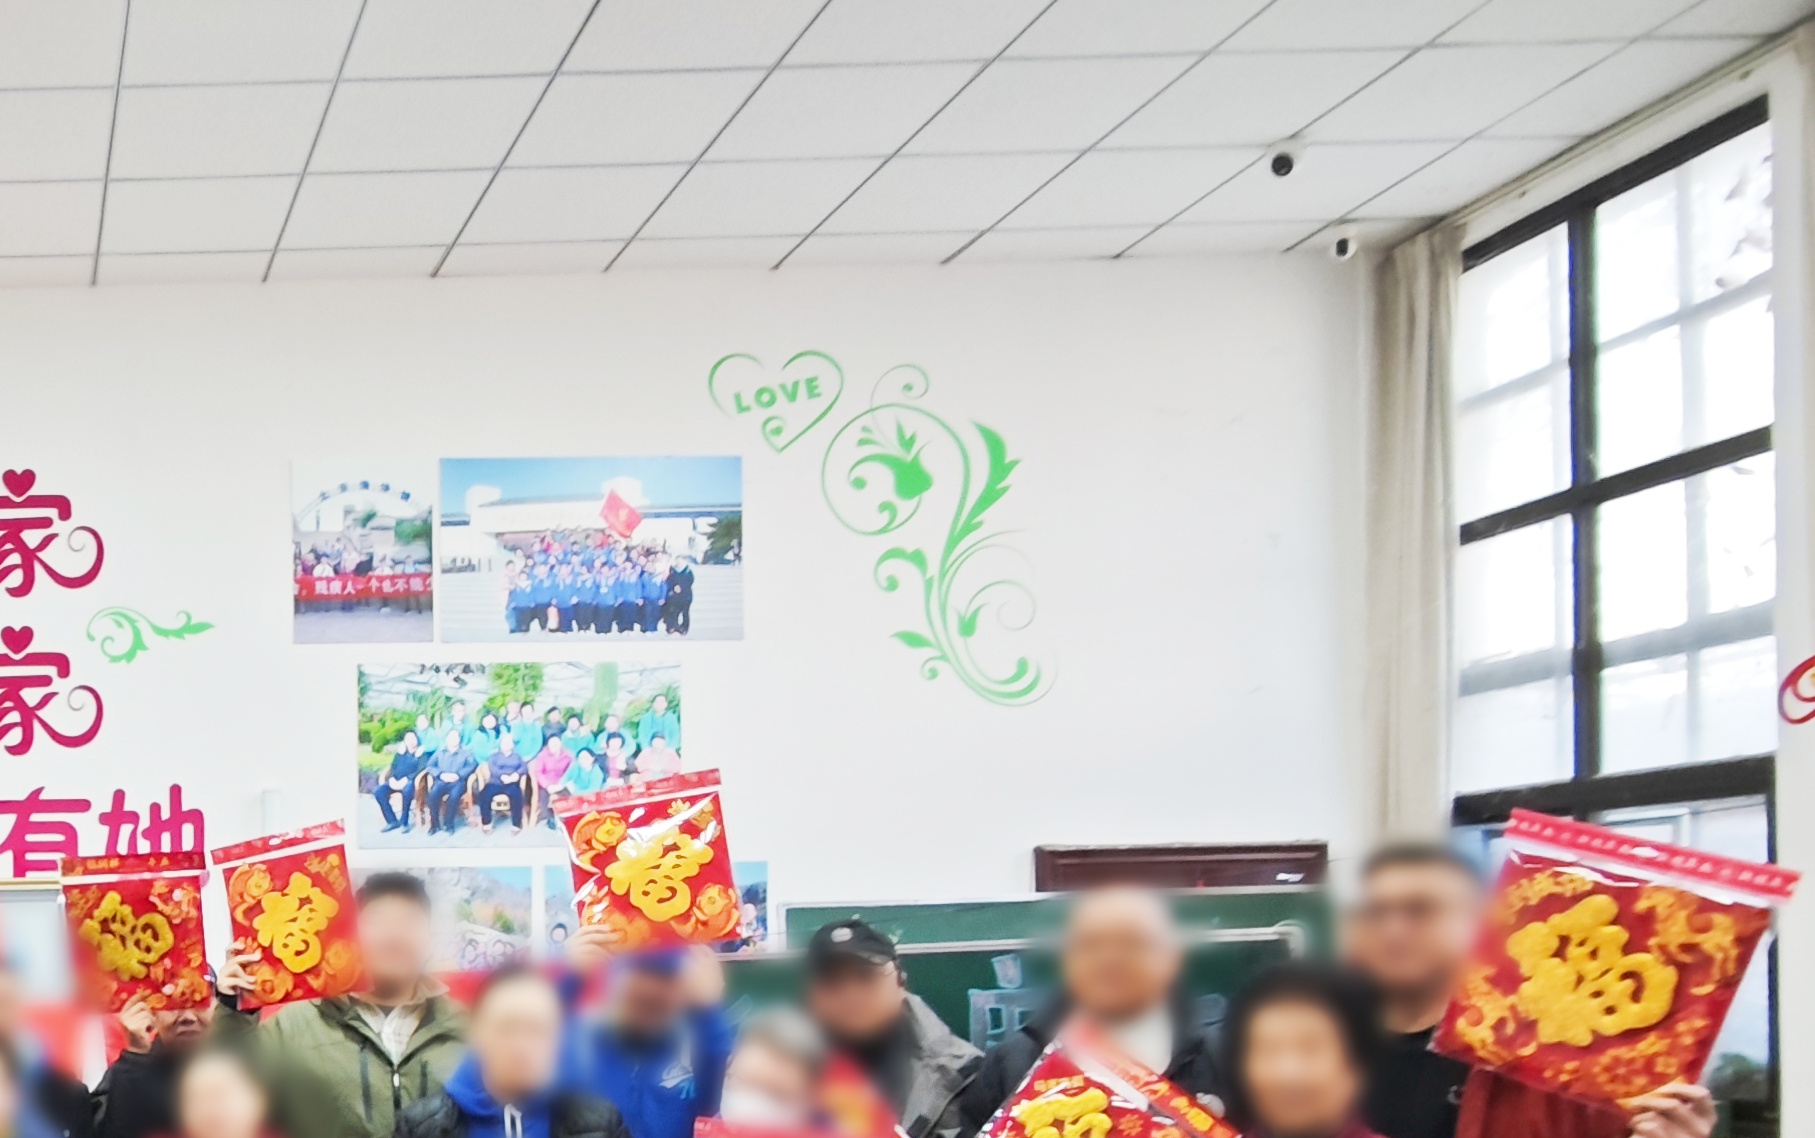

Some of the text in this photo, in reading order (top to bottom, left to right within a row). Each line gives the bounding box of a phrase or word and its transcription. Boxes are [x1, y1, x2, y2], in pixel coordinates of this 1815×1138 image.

[733, 376, 822, 414] LOVE
[252, 871, 339, 973] 福
[605, 825, 714, 922] 福
[79, 891, 174, 981] 福
[1508, 894, 1678, 1046] 福
